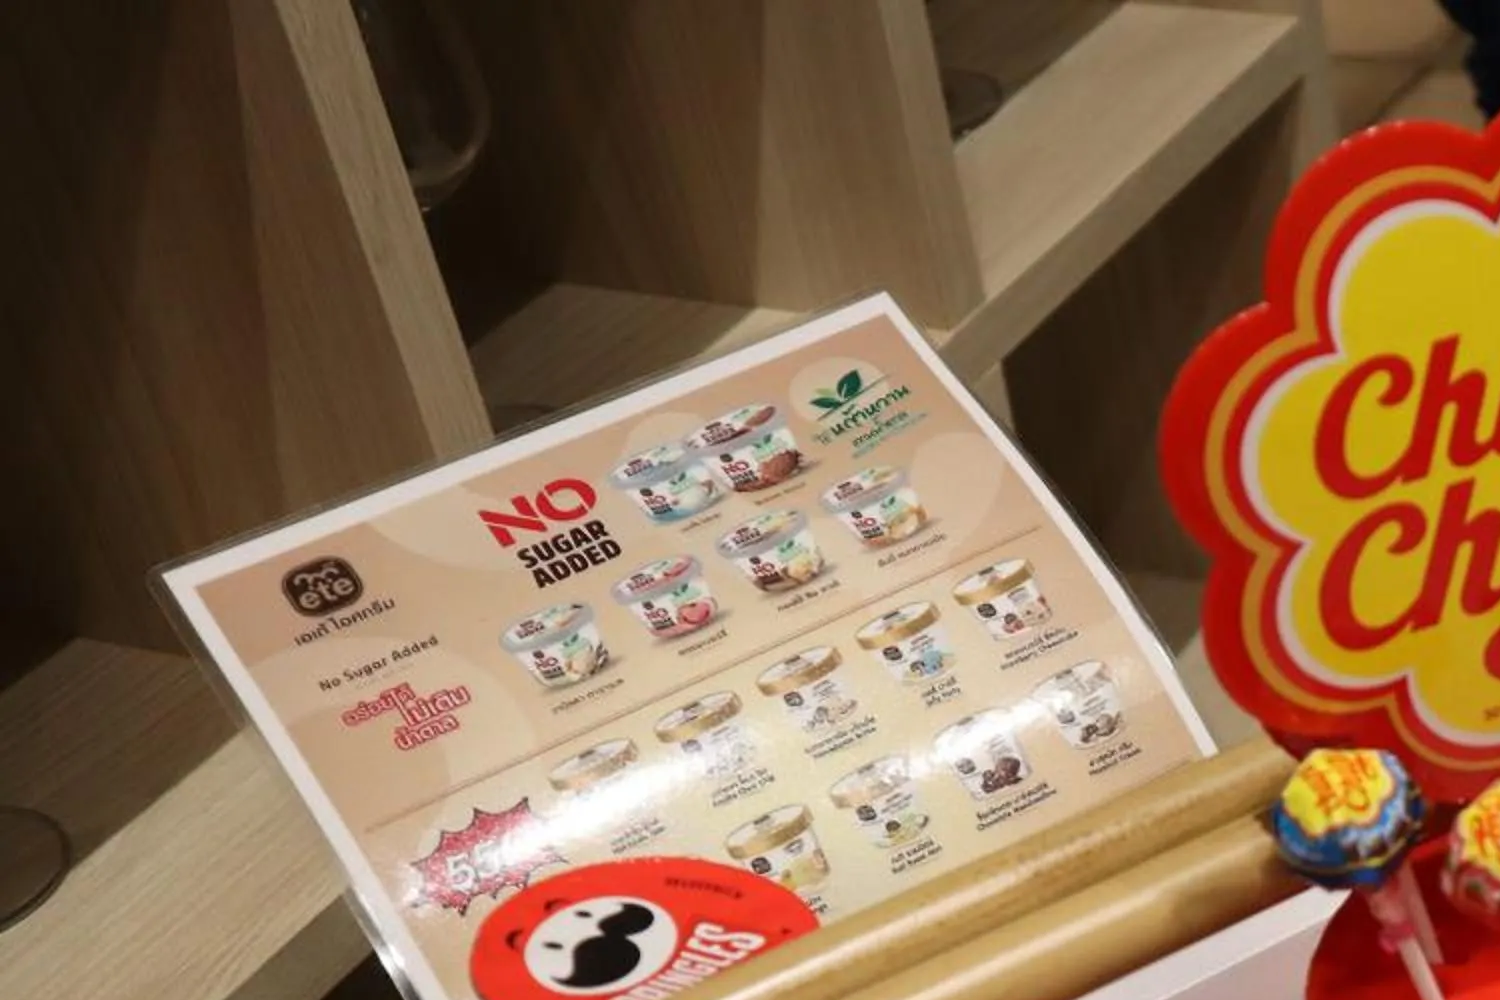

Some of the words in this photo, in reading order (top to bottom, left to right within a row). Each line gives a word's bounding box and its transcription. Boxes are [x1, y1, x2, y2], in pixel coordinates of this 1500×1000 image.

[477, 477, 597, 548] NO
[516, 519, 610, 569] SUGAR
[531, 539, 623, 589] ADDED
[318, 677, 342, 693] No
[342, 656, 389, 684] Sugar
[390, 633, 440, 662] Added
